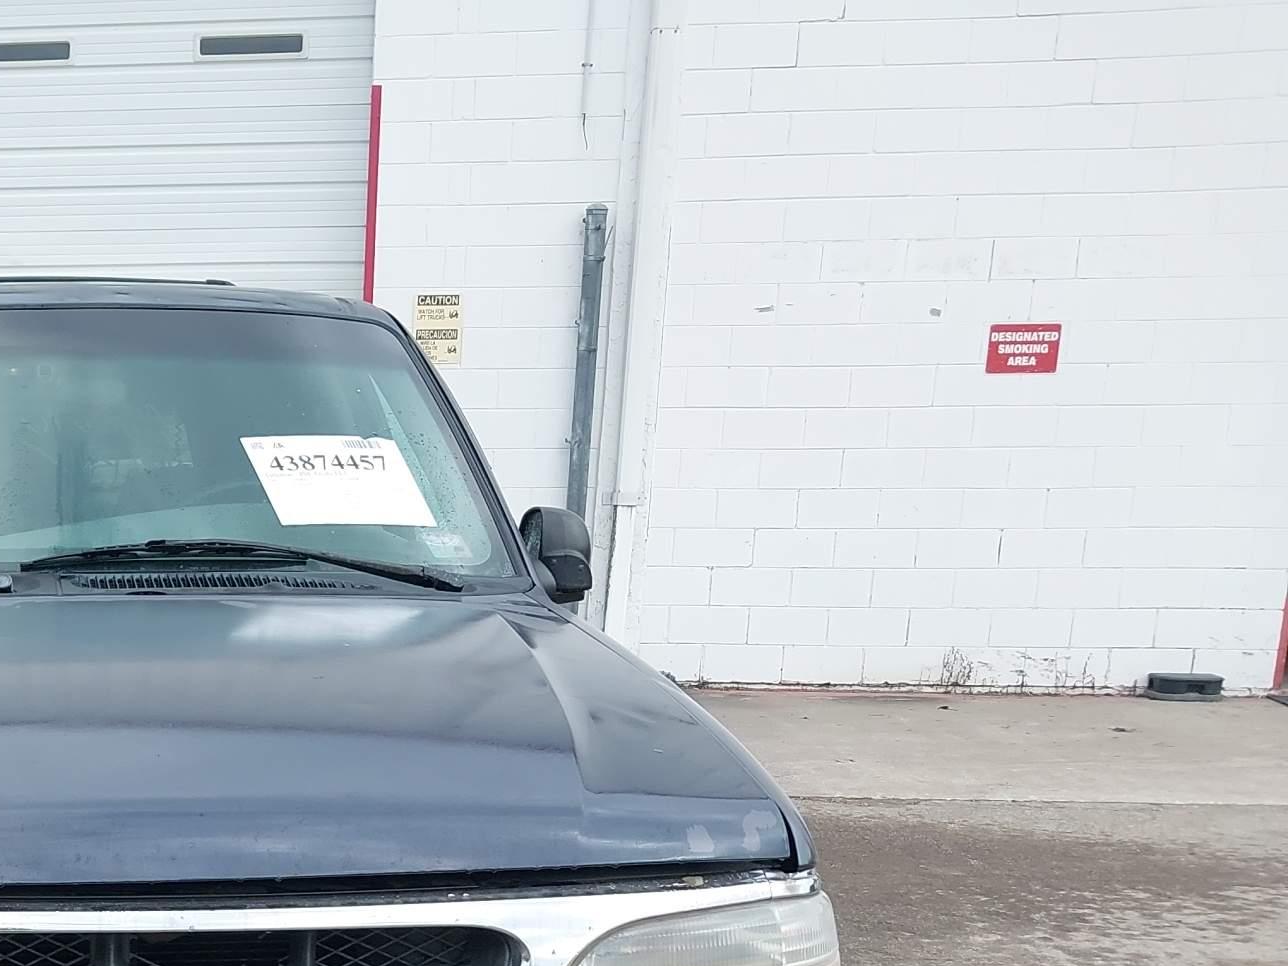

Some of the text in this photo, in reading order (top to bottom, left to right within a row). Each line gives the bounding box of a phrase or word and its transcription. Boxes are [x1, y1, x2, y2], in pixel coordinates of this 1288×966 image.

[418, 295, 459, 305] CAUTION
[991, 331, 1059, 342] DESIGNATED
[997, 343, 1049, 354] SMOKING
[1006, 355, 1037, 366] AREA
[269, 454, 386, 471] 43874457
